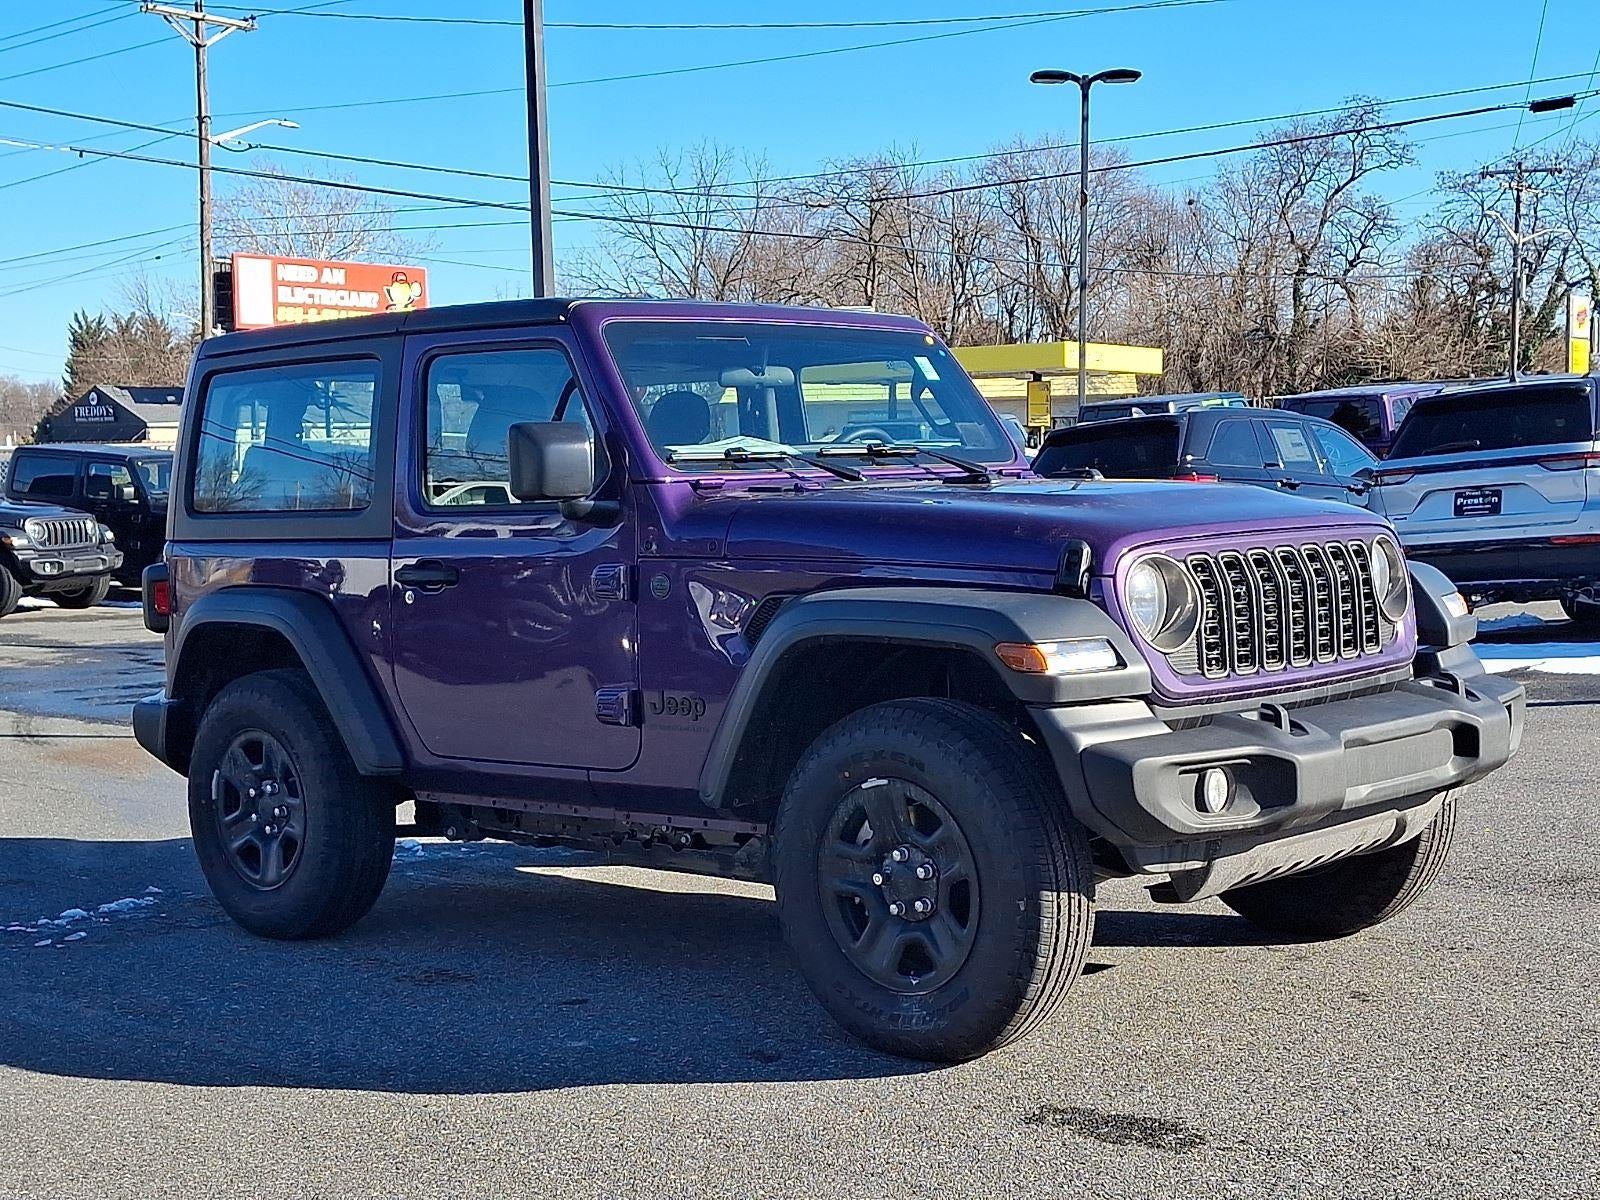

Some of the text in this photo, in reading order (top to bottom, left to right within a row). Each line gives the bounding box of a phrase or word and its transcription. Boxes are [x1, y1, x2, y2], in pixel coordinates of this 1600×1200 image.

[277, 263, 346, 285] NEED AN
[75, 405, 114, 417] FREDDY'S
[649, 688, 707, 722] Jeep
